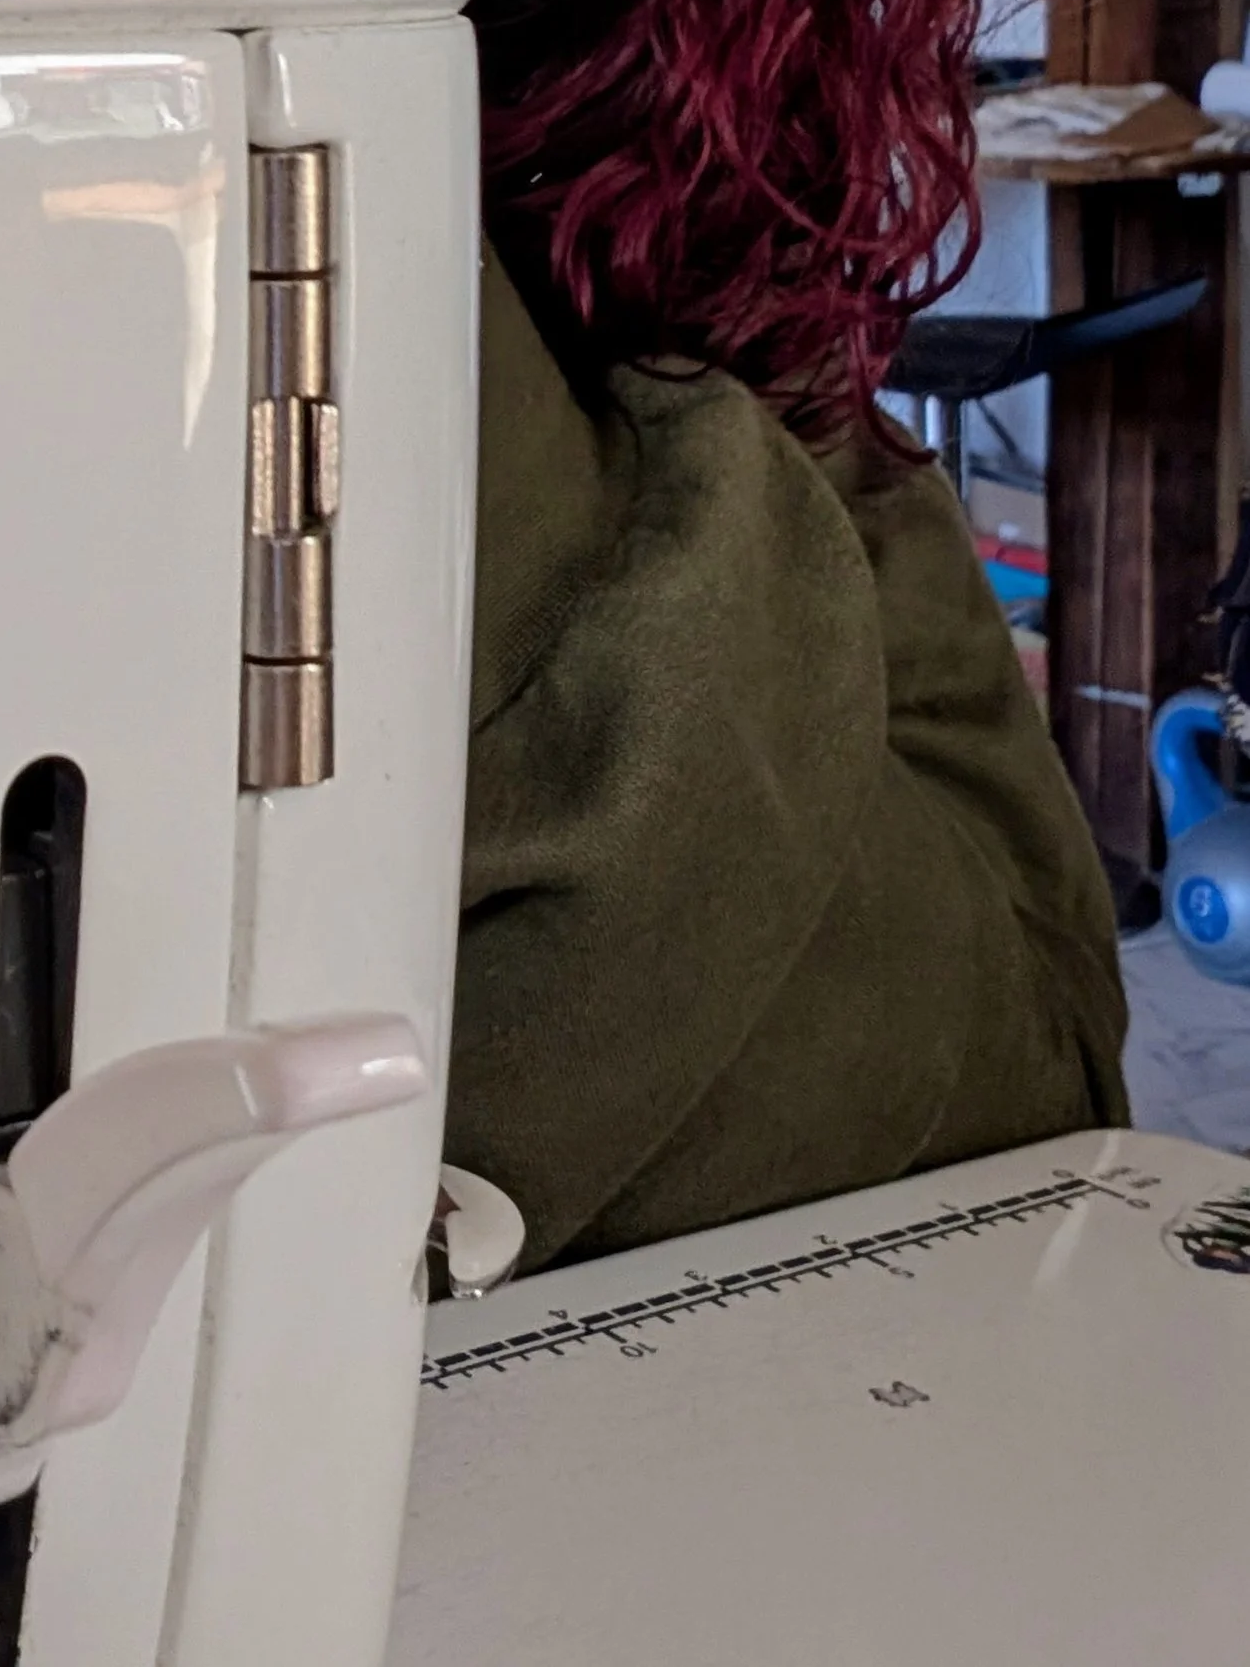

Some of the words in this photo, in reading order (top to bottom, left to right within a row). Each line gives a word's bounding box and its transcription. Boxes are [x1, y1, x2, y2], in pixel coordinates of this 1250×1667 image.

[812, 1232, 838, 1247] 2
[683, 1268, 709, 1282] 3
[547, 1307, 569, 1321] 4
[619, 1340, 659, 1360] 10
